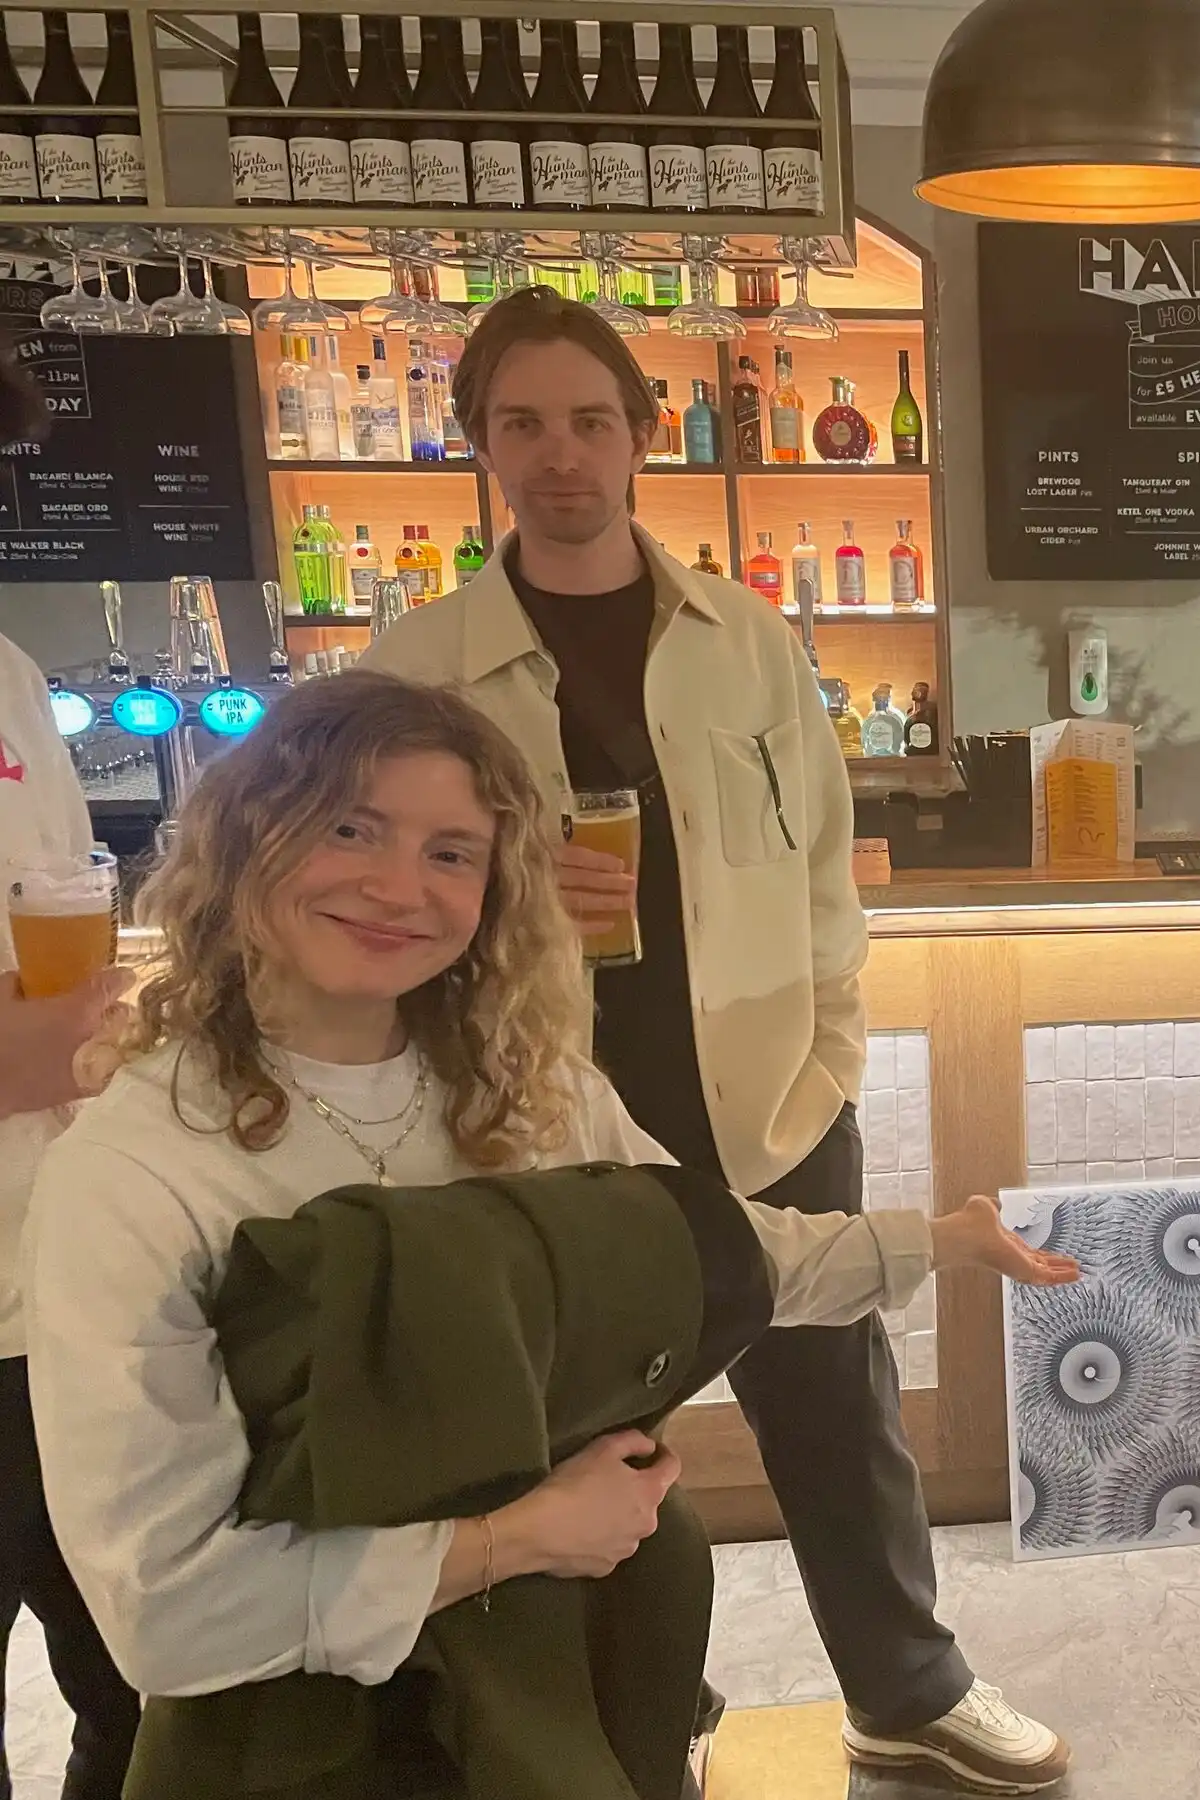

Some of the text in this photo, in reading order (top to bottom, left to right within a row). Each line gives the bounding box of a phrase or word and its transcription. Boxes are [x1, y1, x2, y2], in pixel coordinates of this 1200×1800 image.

[118, 161, 145, 172] ma
[230, 149, 267, 177] Hunts
[250, 162, 284, 174] man
[291, 150, 333, 179] Hunts
[352, 152, 393, 182] Hunts
[315, 164, 348, 176] man
[376, 165, 409, 177] man
[427, 165, 459, 177] man
[484, 165, 516, 178] man
[533, 154, 576, 186] Hunts
[590, 156, 630, 187] Hunts
[614, 169, 644, 181] man
[653, 157, 699, 189] Hunts
[708, 158, 749, 190] Hunts
[767, 161, 810, 192] Hunts
[1161, 356, 1174, 365] us
[1136, 386, 1152, 397] for
[1155, 379, 1175, 396] £5
[1136, 413, 1177, 423] available
[157, 445, 200, 457] WINE
[1038, 451, 1080, 464] PINTS
[1174, 478, 1191, 487] GIN
[1026, 488, 1048, 497] LOST
[1117, 507, 1196, 517] KETEL ONE VODKA
[153, 522, 186, 532] HOUSE
[1024, 525, 1099, 535] URBAN ORCHARD
[10, 541, 50, 550] WALKER
[53, 541, 85, 550] BLACK
[1040, 536, 1066, 545] CIDER
[1153, 543, 1191, 552] JOHNNIE
[1164, 552, 1189, 561] LABEL
[219, 698, 248, 711] PUNK
[226, 711, 245, 725] IPA
